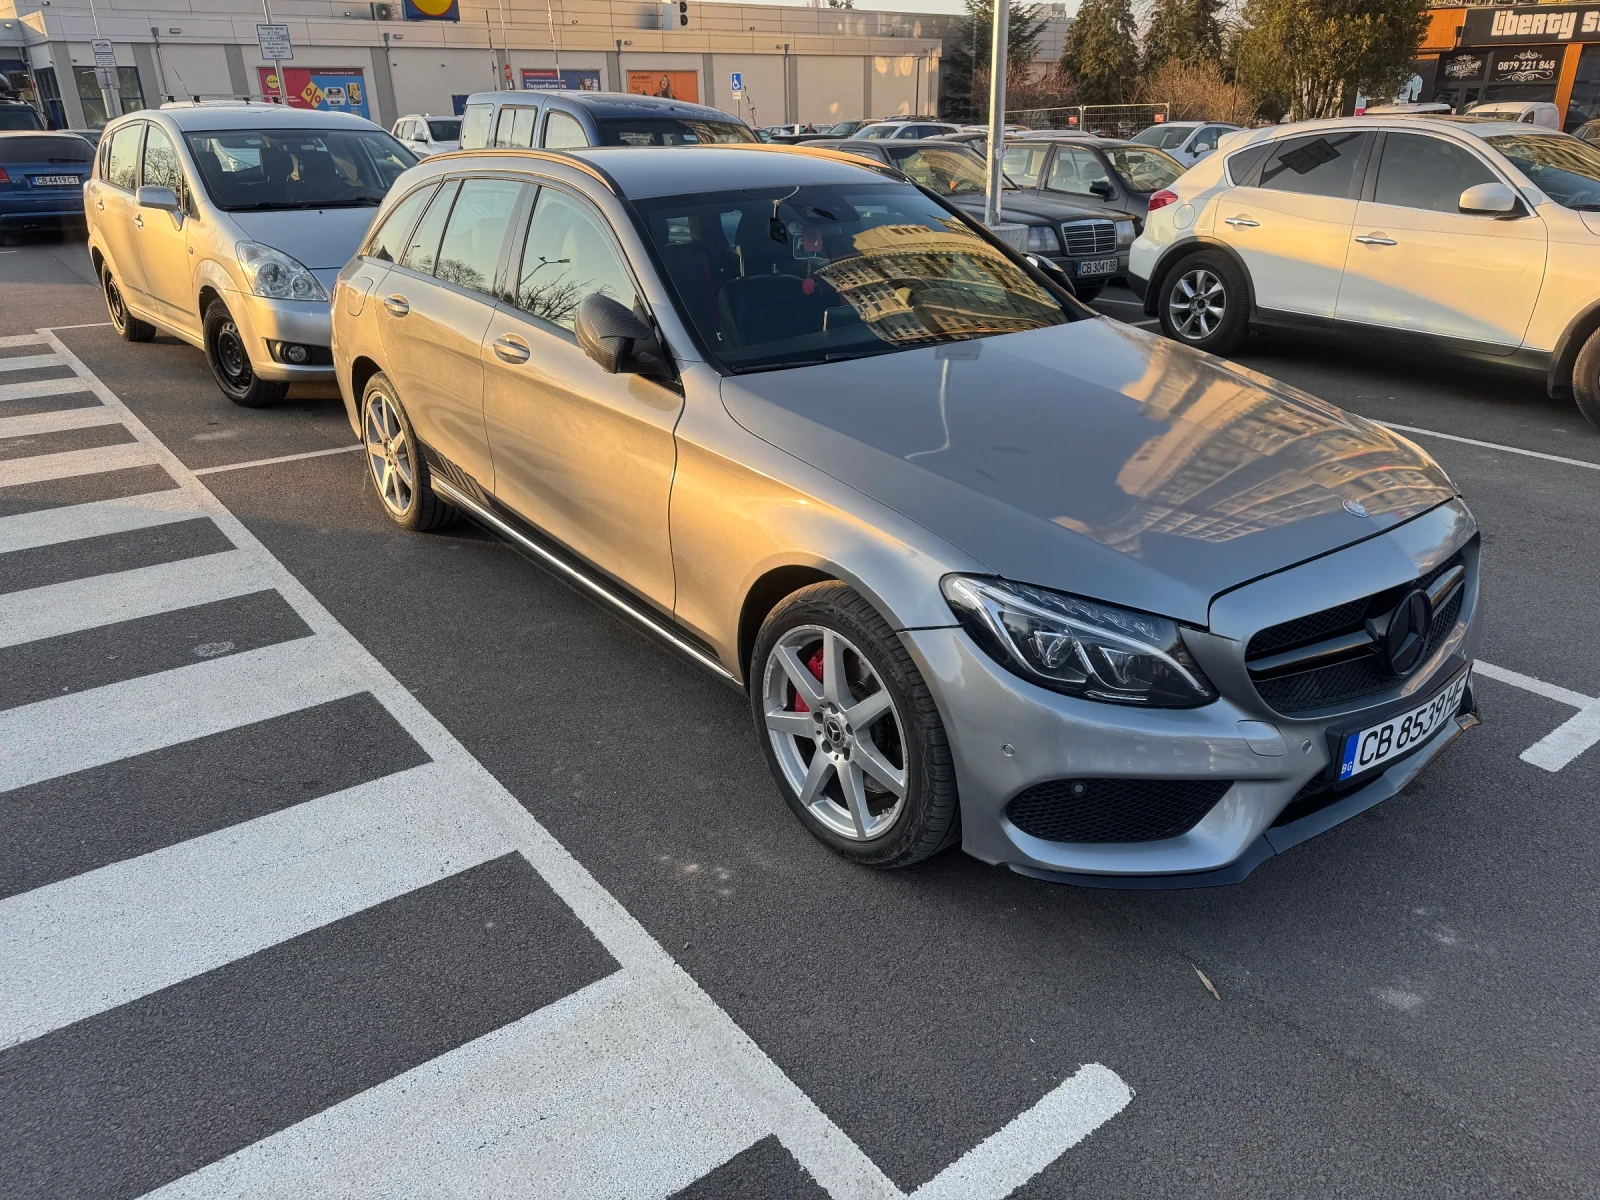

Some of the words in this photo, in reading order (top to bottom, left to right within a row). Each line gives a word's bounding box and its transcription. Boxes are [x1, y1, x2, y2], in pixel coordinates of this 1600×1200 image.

[1581, 11, 1600, 32] S
[1498, 61, 1519, 70] 0879
[1520, 61, 1536, 70] 221
[1081, 262, 1092, 274] CB
[1093, 261, 1108, 273] 3041
[837, 614, 868, 641] 225/45
[873, 649, 885, 662] 18
[1359, 724, 1394, 766] CB
[1396, 693, 1446, 749] 8539
[1443, 672, 1467, 720] HE
[1341, 761, 1353, 774] BG
